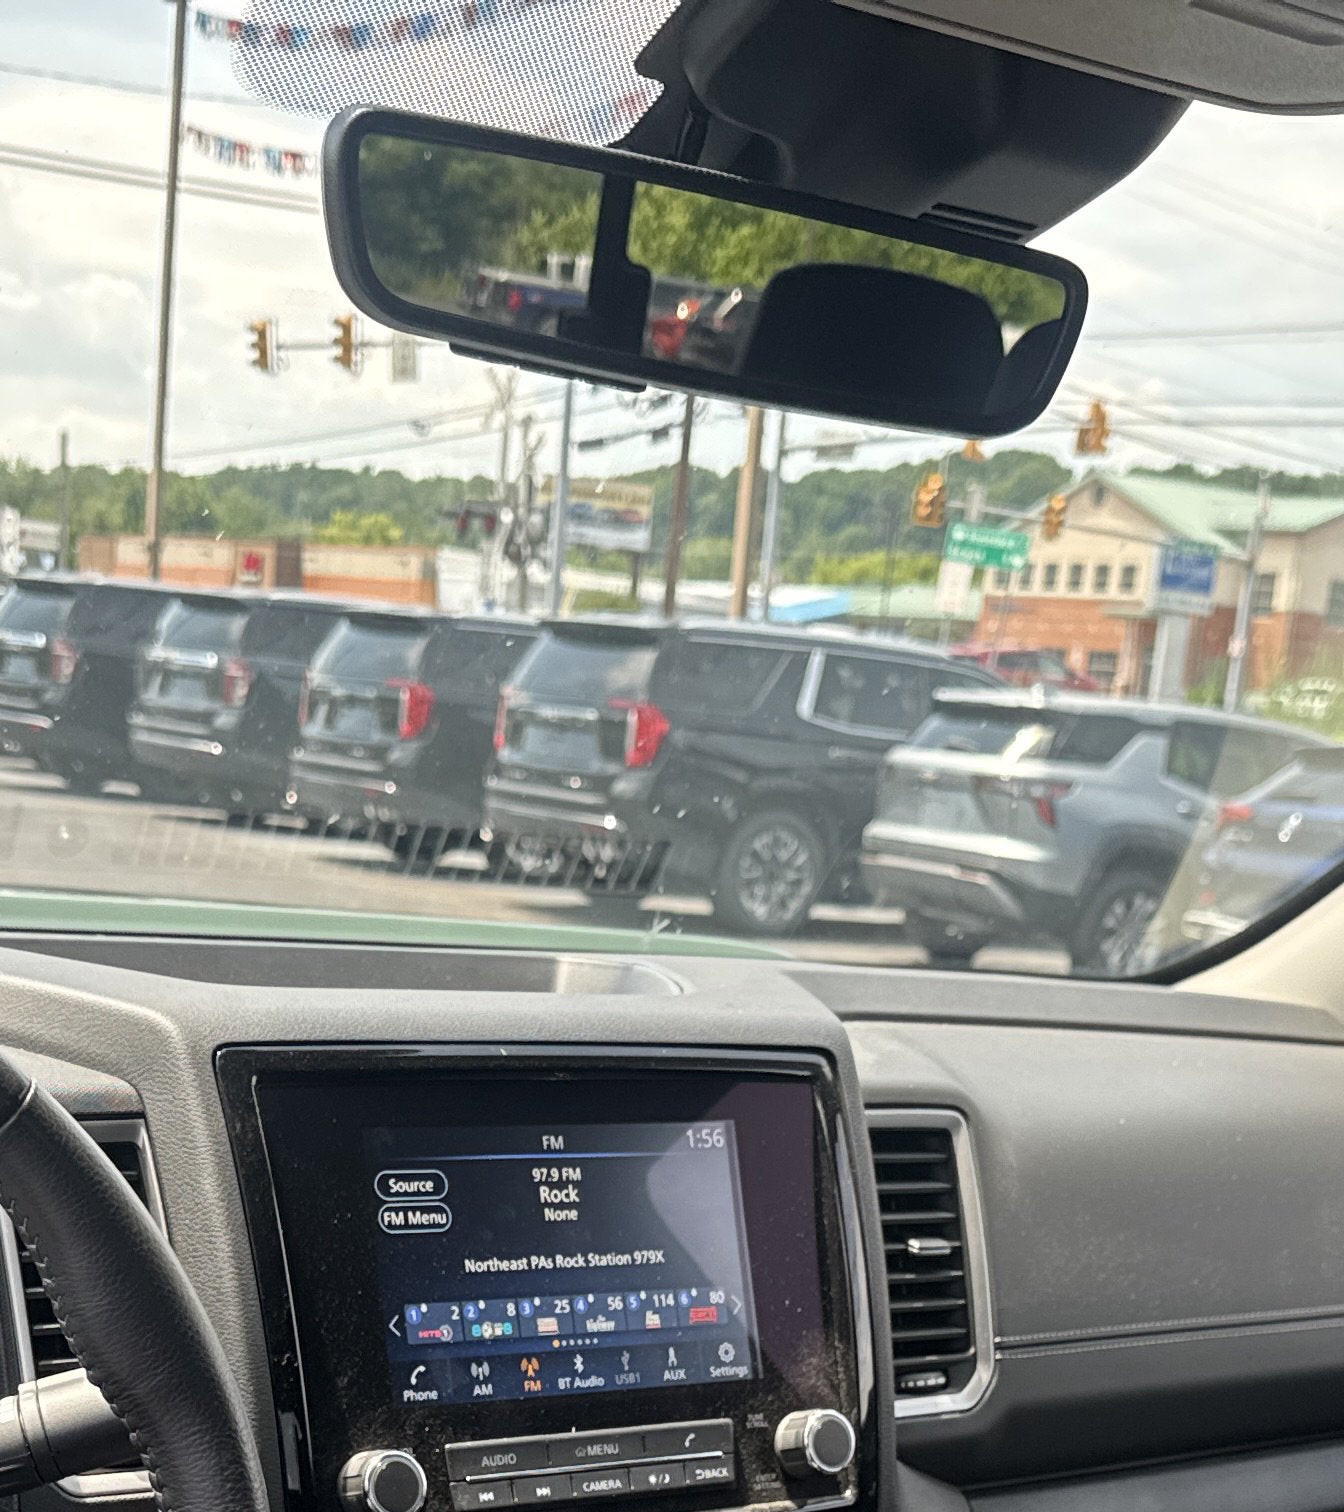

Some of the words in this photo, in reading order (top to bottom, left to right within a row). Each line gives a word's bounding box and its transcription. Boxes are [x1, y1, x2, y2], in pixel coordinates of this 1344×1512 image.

[542, 1135, 565, 1150] FM
[686, 1128, 725, 1149] 1:56
[531, 1167, 560, 1182] 97.9
[561, 1167, 582, 1182] FM
[388, 1178, 435, 1193] Source
[539, 1185, 580, 1204] Rock
[383, 1211, 405, 1226] FM
[407, 1210, 447, 1226] Menu
[544, 1207, 579, 1222] None
[464, 1256, 529, 1274] Northeast
[530, 1255, 554, 1270] PAs
[555, 1253, 587, 1268] Rock
[587, 1252, 632, 1267] Station
[633, 1250, 665, 1265] 979X
[607, 1295, 624, 1311] 56
[629, 1298, 637, 1309] 5
[653, 1293, 675, 1308] 114
[681, 1294, 689, 1305] 6
[709, 1290, 725, 1304] 80
[450, 1305, 460, 1320] 2
[467, 1306, 475, 1318] 2
[506, 1302, 516, 1317] 8
[522, 1303, 530, 1315] 3
[553, 1299, 571, 1314] 25
[577, 1300, 585, 1311] 4
[410, 1309, 418, 1321] 1
[615, 1371, 641, 1385] USB1
[663, 1368, 687, 1382] AUX
[709, 1364, 749, 1379] Settings
[523, 1379, 542, 1392] FM
[557, 1376, 573, 1390] BT
[573, 1374, 605, 1388] Audio
[403, 1388, 438, 1402] Phone
[473, 1384, 494, 1397] AM
[587, 1442, 620, 1458] MENU
[481, 1451, 517, 1467] AUDIO
[706, 1467, 729, 1479] BACK
[582, 1476, 623, 1493] CAMERA
